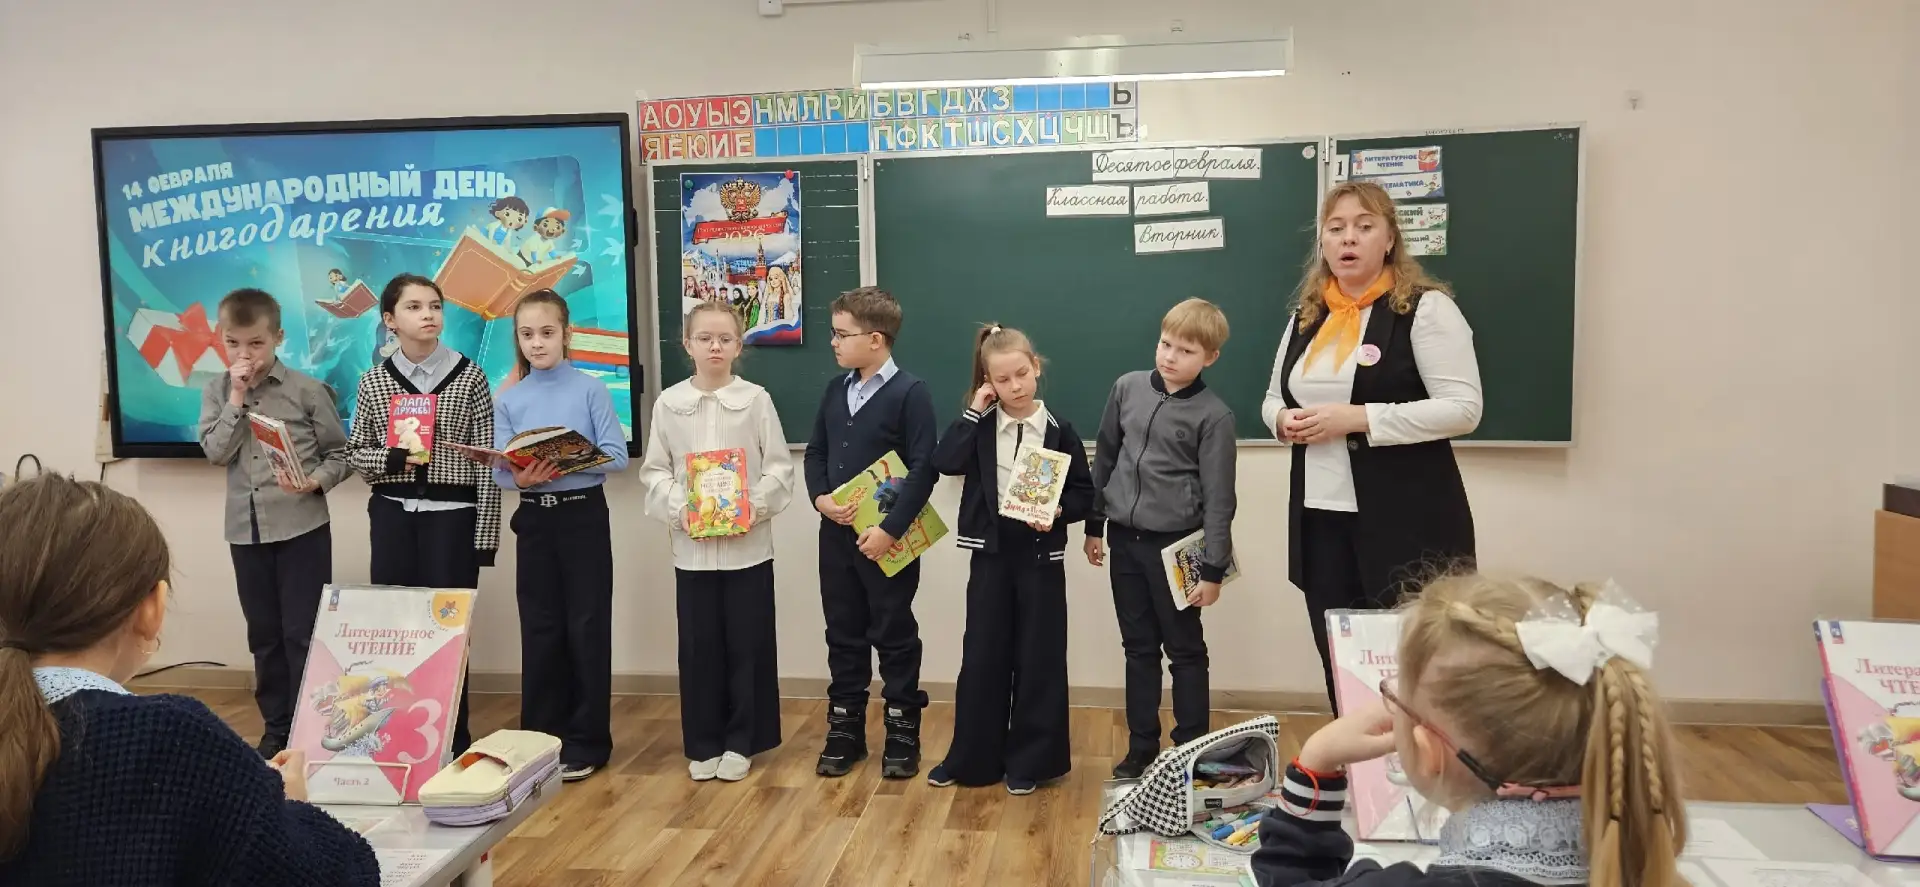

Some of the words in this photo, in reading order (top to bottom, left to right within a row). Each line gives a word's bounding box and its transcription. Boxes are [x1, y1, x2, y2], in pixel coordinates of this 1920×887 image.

[1364, 154, 1417, 163] ЛИТЕРАТУРНОЕ
[1335, 160, 1345, 176] 1
[122, 181, 143, 200] 14
[148, 161, 234, 194] ФЕВРАЛЯ
[1383, 180, 1425, 189] ТЕМАТИКА
[128, 163, 422, 233] МЕЖДУНАРОДНЫЙ
[432, 170, 517, 200] ДЕНЬ
[142, 202, 445, 268] книгодарения
[400, 396, 431, 407] ЛАПА
[393, 406, 432, 417] ДРУЖБЫ
[334, 622, 435, 643] Литературное
[347, 641, 417, 657] ЧТЕНИЕ
[397, 698, 442, 764] 3
[333, 777, 361, 787] Часть
[363, 777, 370, 786] 2
